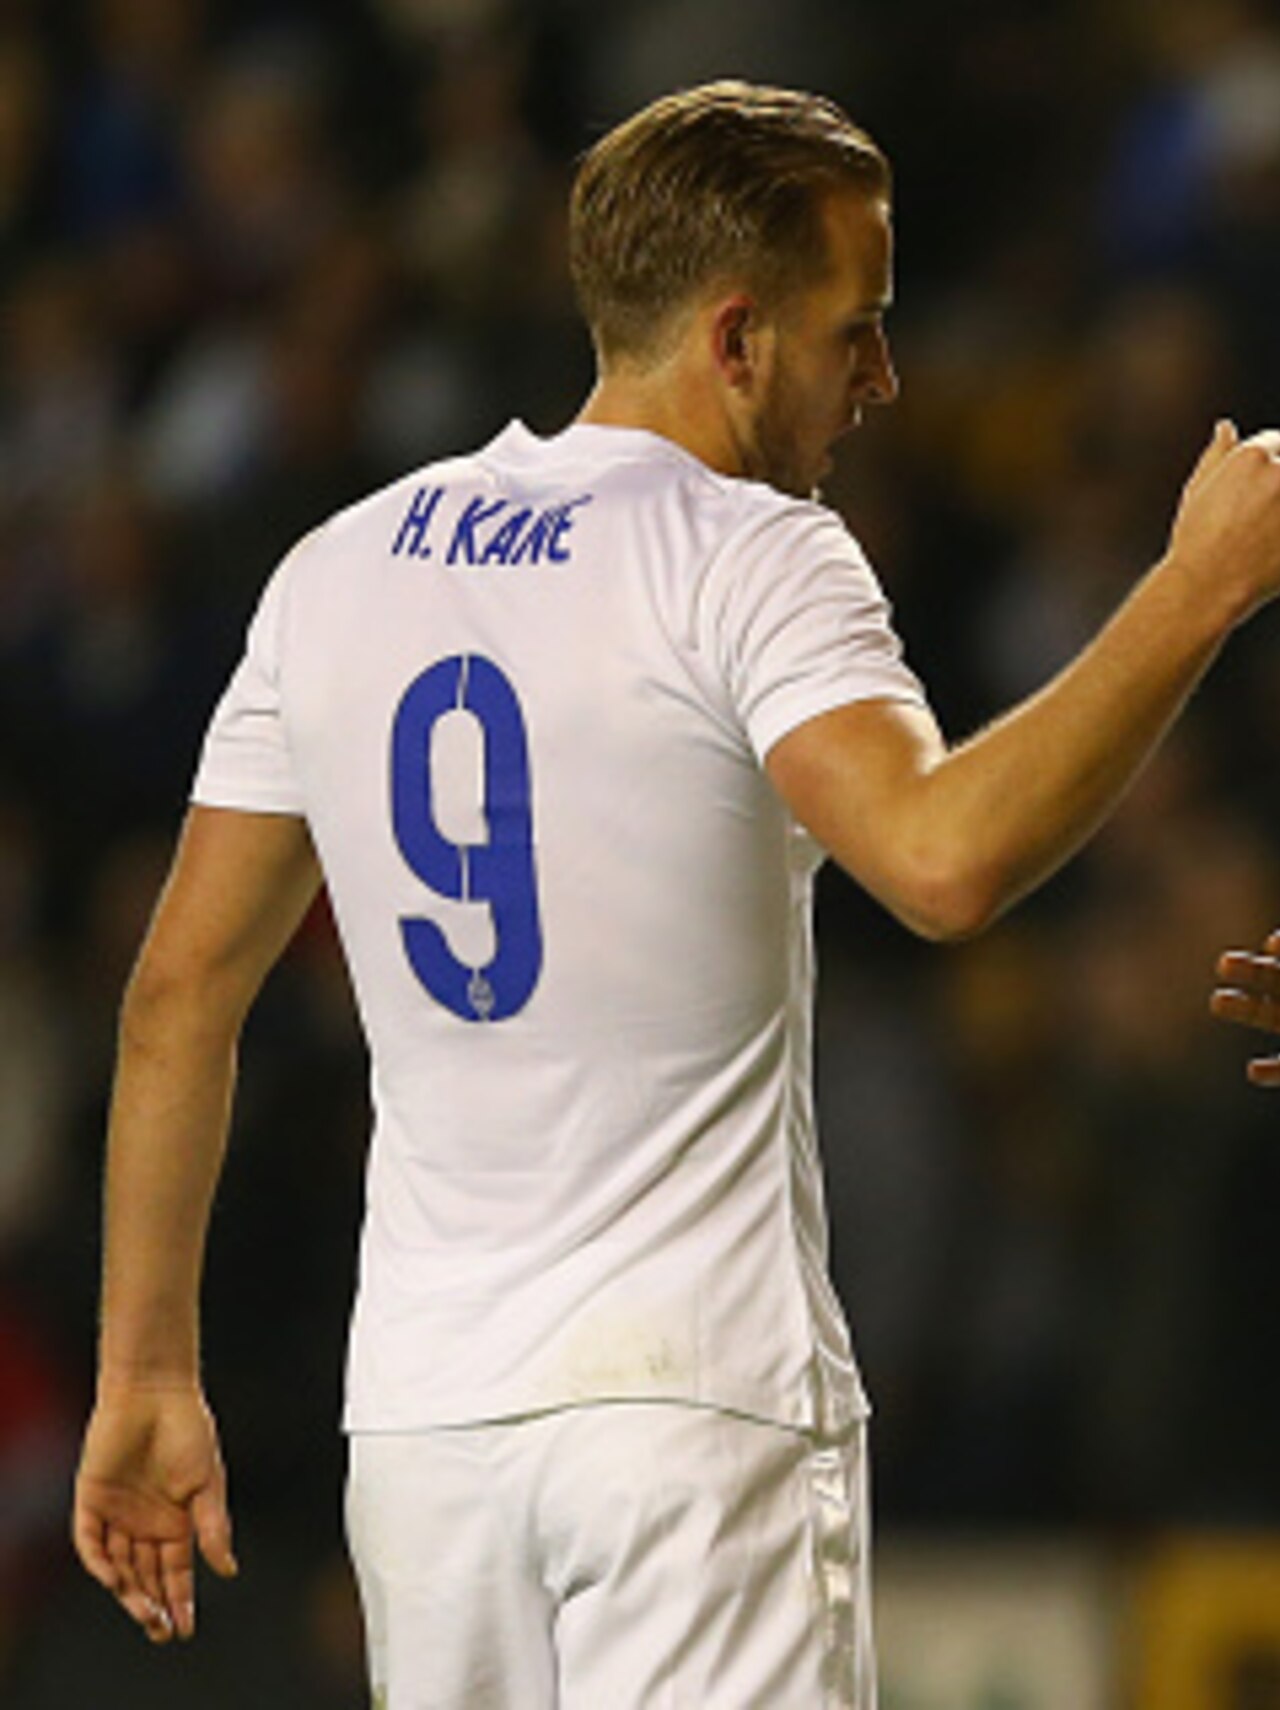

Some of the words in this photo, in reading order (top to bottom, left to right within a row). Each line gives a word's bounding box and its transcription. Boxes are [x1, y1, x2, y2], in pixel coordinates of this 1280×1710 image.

[391, 486, 444, 559] H.
[446, 493, 593, 565] KANE
[390, 654, 543, 1022] 9
